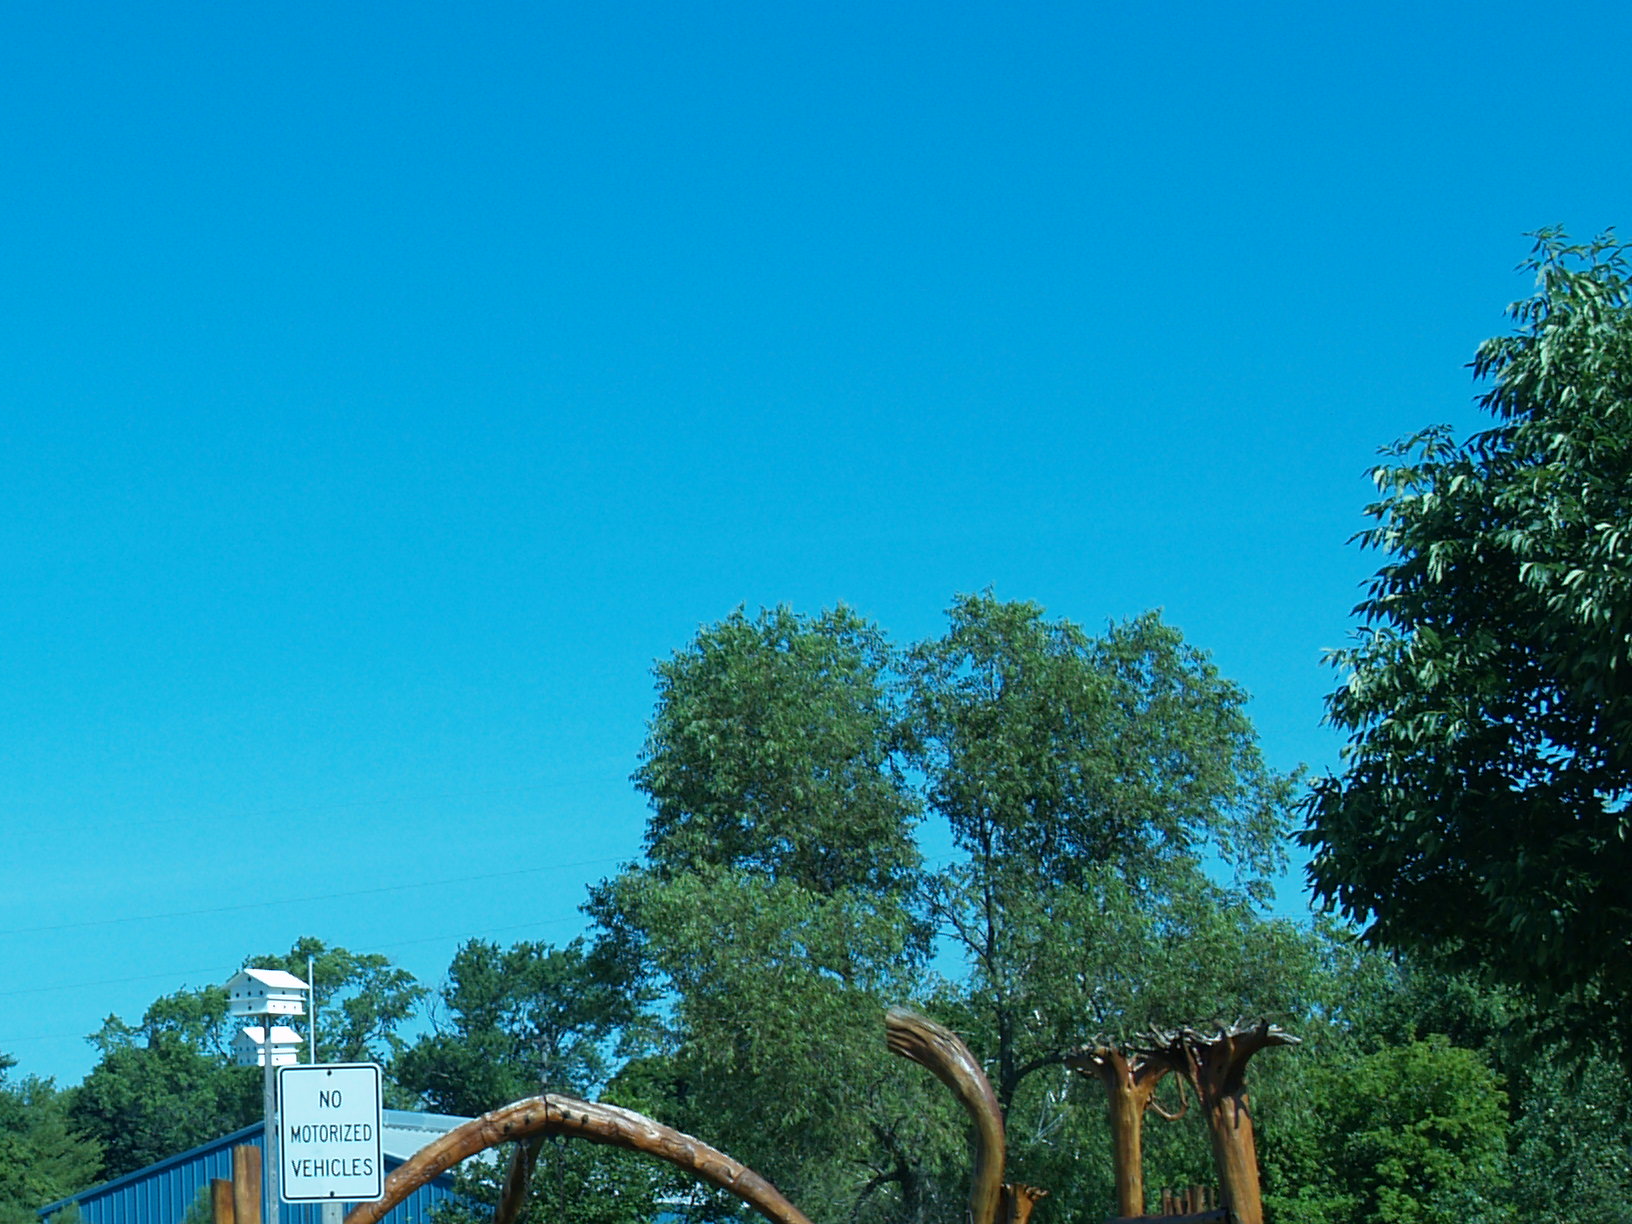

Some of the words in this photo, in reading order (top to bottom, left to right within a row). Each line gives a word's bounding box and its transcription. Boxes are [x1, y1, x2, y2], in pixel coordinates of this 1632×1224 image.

[319, 1090, 342, 1108] NO
[290, 1124, 372, 1143] MOTORIZED
[291, 1158, 373, 1177] VEHICLES
